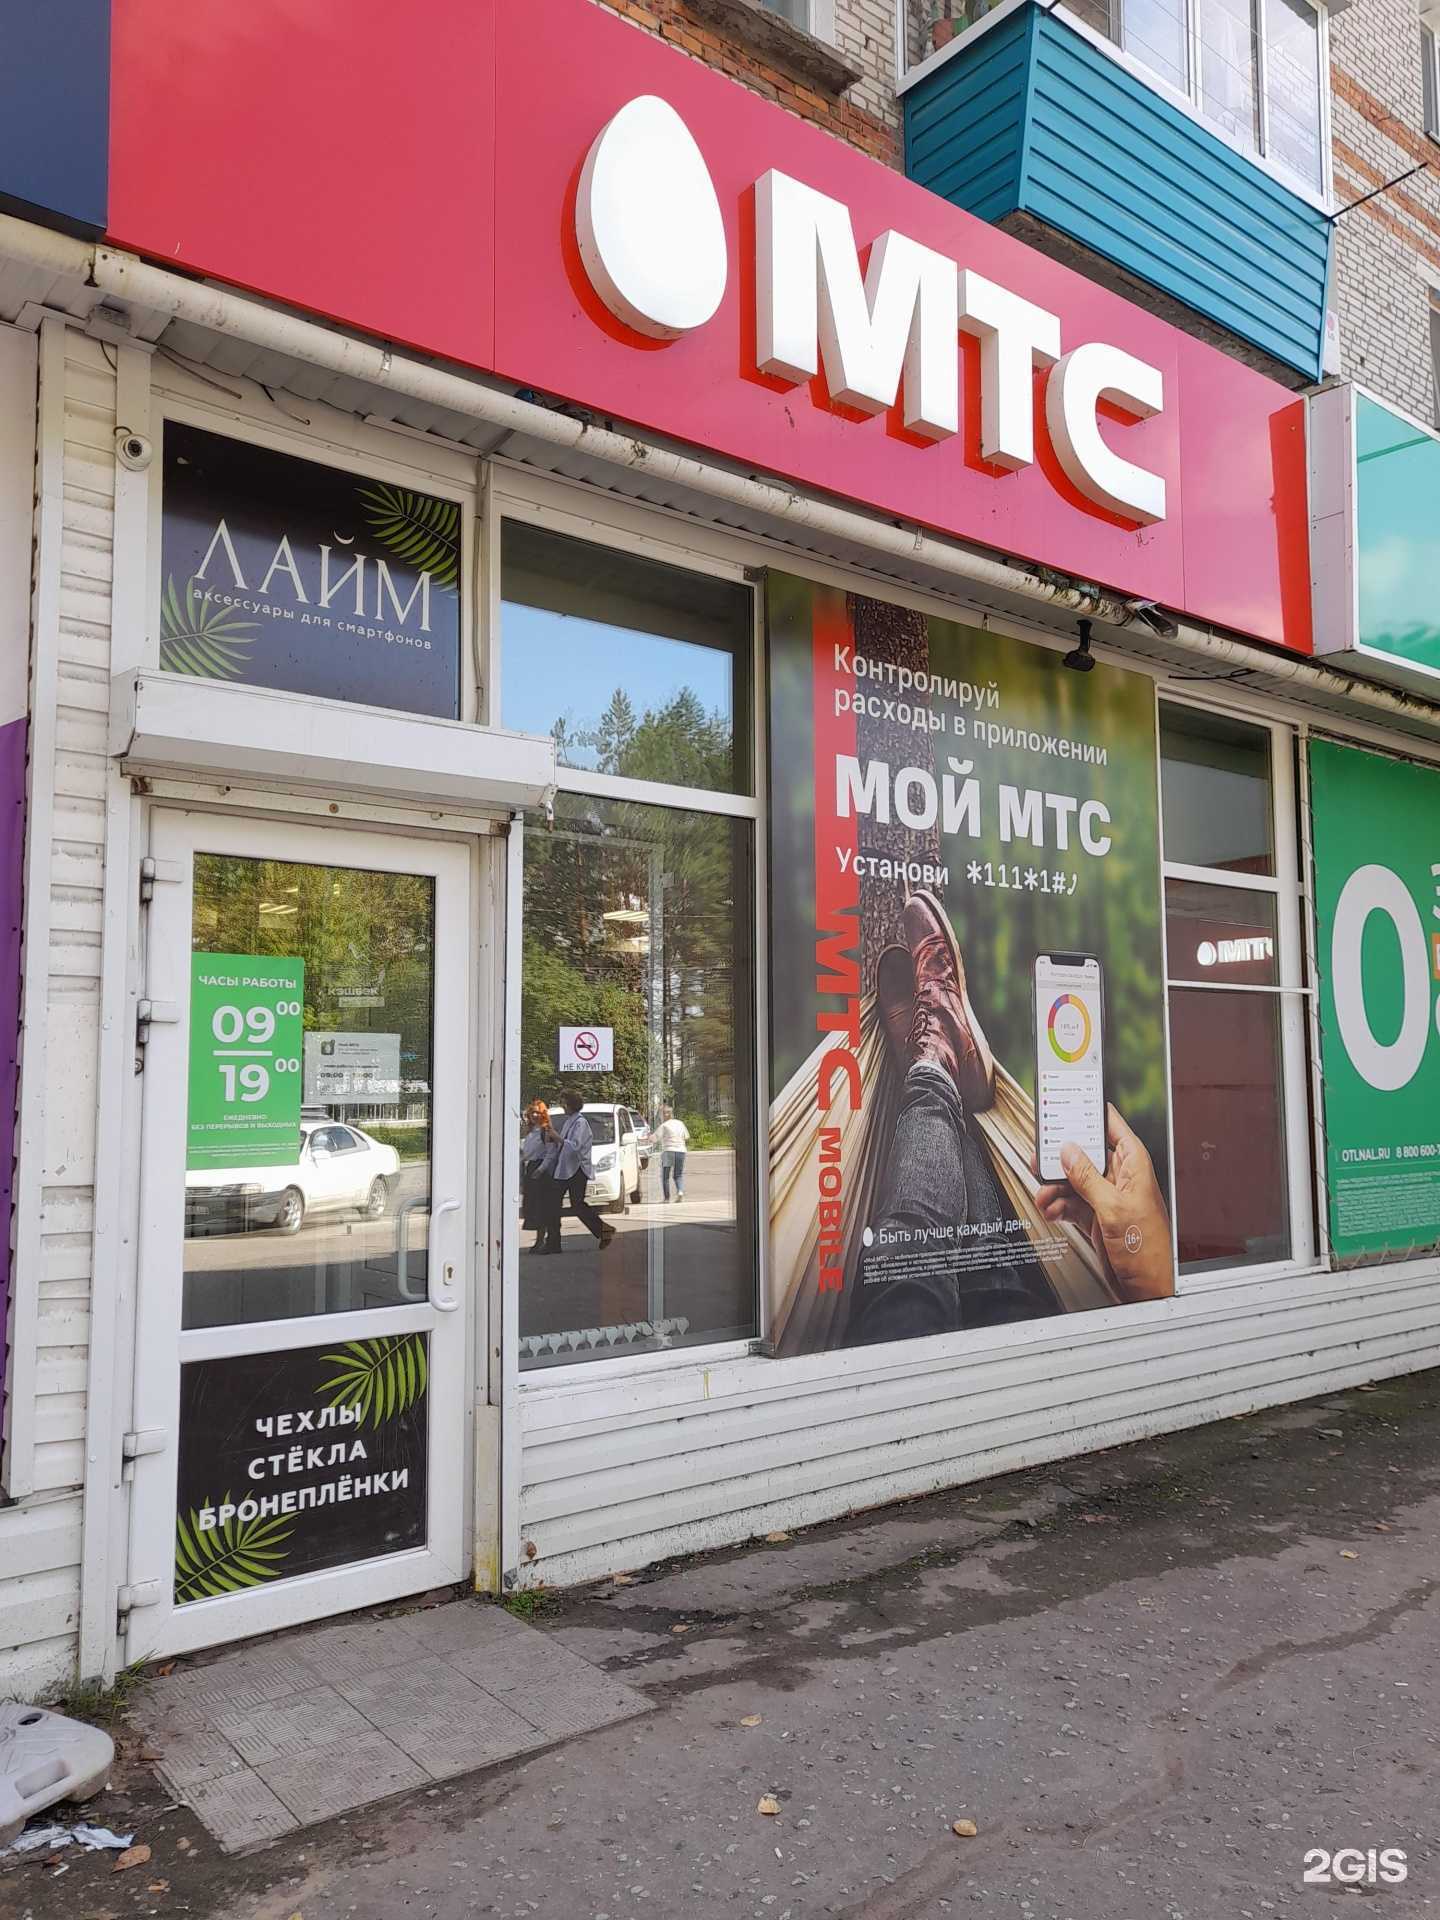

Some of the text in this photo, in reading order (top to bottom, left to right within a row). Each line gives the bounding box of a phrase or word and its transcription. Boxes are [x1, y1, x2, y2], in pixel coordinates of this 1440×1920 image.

[755, 168, 1166, 523] МТС
[193, 519, 432, 632] ЛАЙМ
[193, 588, 432, 650] аксессуары для смартфонов
[834, 643, 1000, 710] Контролируй
[834, 686, 1108, 766] расходы в приложении
[835, 753, 1112, 857] МОЙ МТС
[835, 847, 949, 886] Установи
[198, 975, 297, 989] ЧАСЫ РАБОТЫ
[212, 1001, 301, 1043] 09 00
[218, 1058, 300, 1102] 19 00
[563, 1062, 609, 1071] НЕ КУРИТЬ!
[1342, 1147, 1391, 1162] OTLNAL.RU
[818, 1127, 843, 1292] MOBILE
[879, 1217, 1032, 1245] Быть лучше каждый день
[256, 1402, 362, 1438] ЧЕХЛЫ
[247, 1439, 368, 1480] СТЁКЛА
[199, 1468, 409, 1531] БРОНЕПЛЁНКИ
